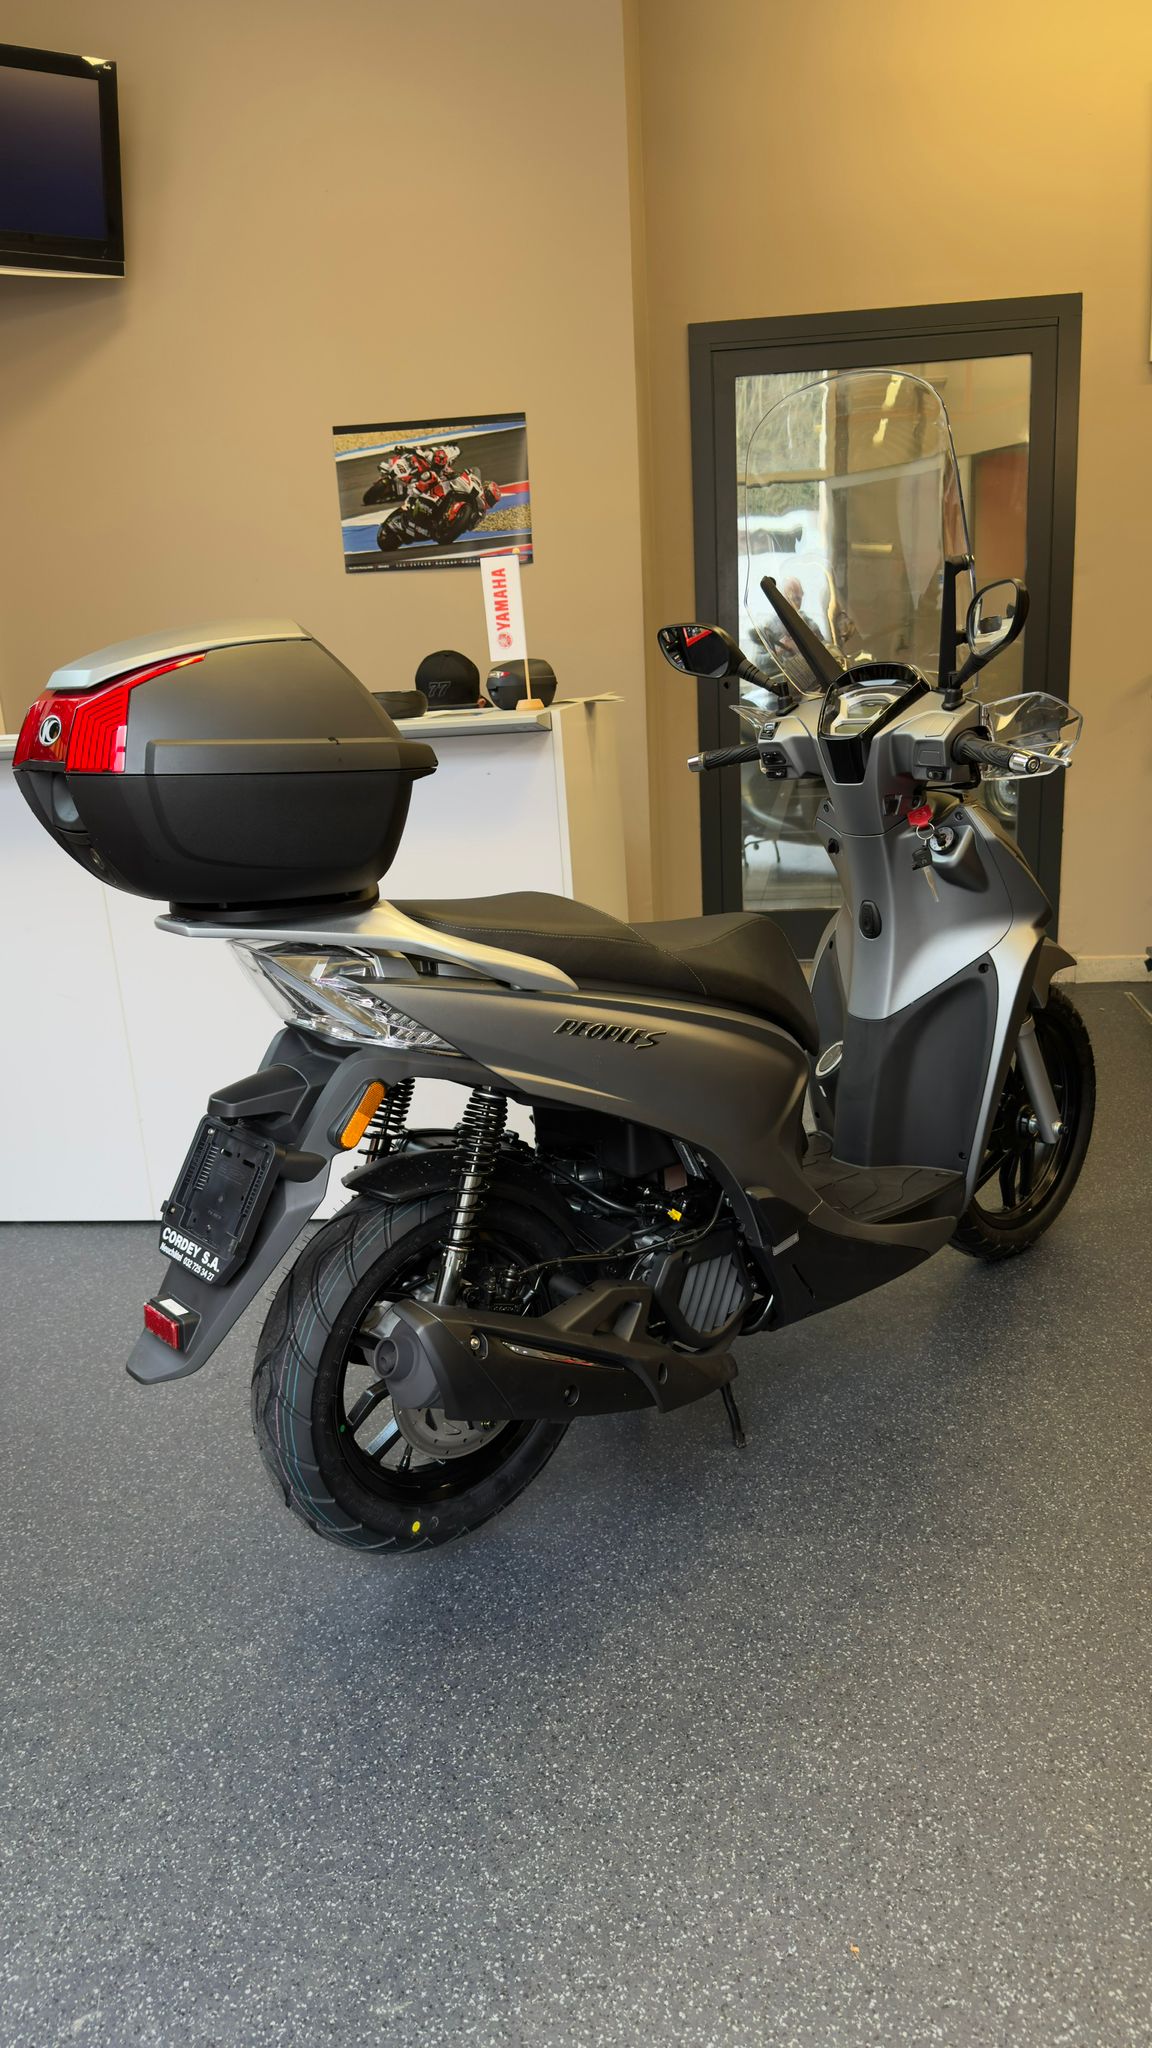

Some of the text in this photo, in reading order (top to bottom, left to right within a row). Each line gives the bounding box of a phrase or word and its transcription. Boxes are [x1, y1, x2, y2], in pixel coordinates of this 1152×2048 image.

[491, 567, 511, 631] YAMAHA
[428, 680, 451, 697] 77
[162, 1227, 220, 1273] CORDEY S.A.
